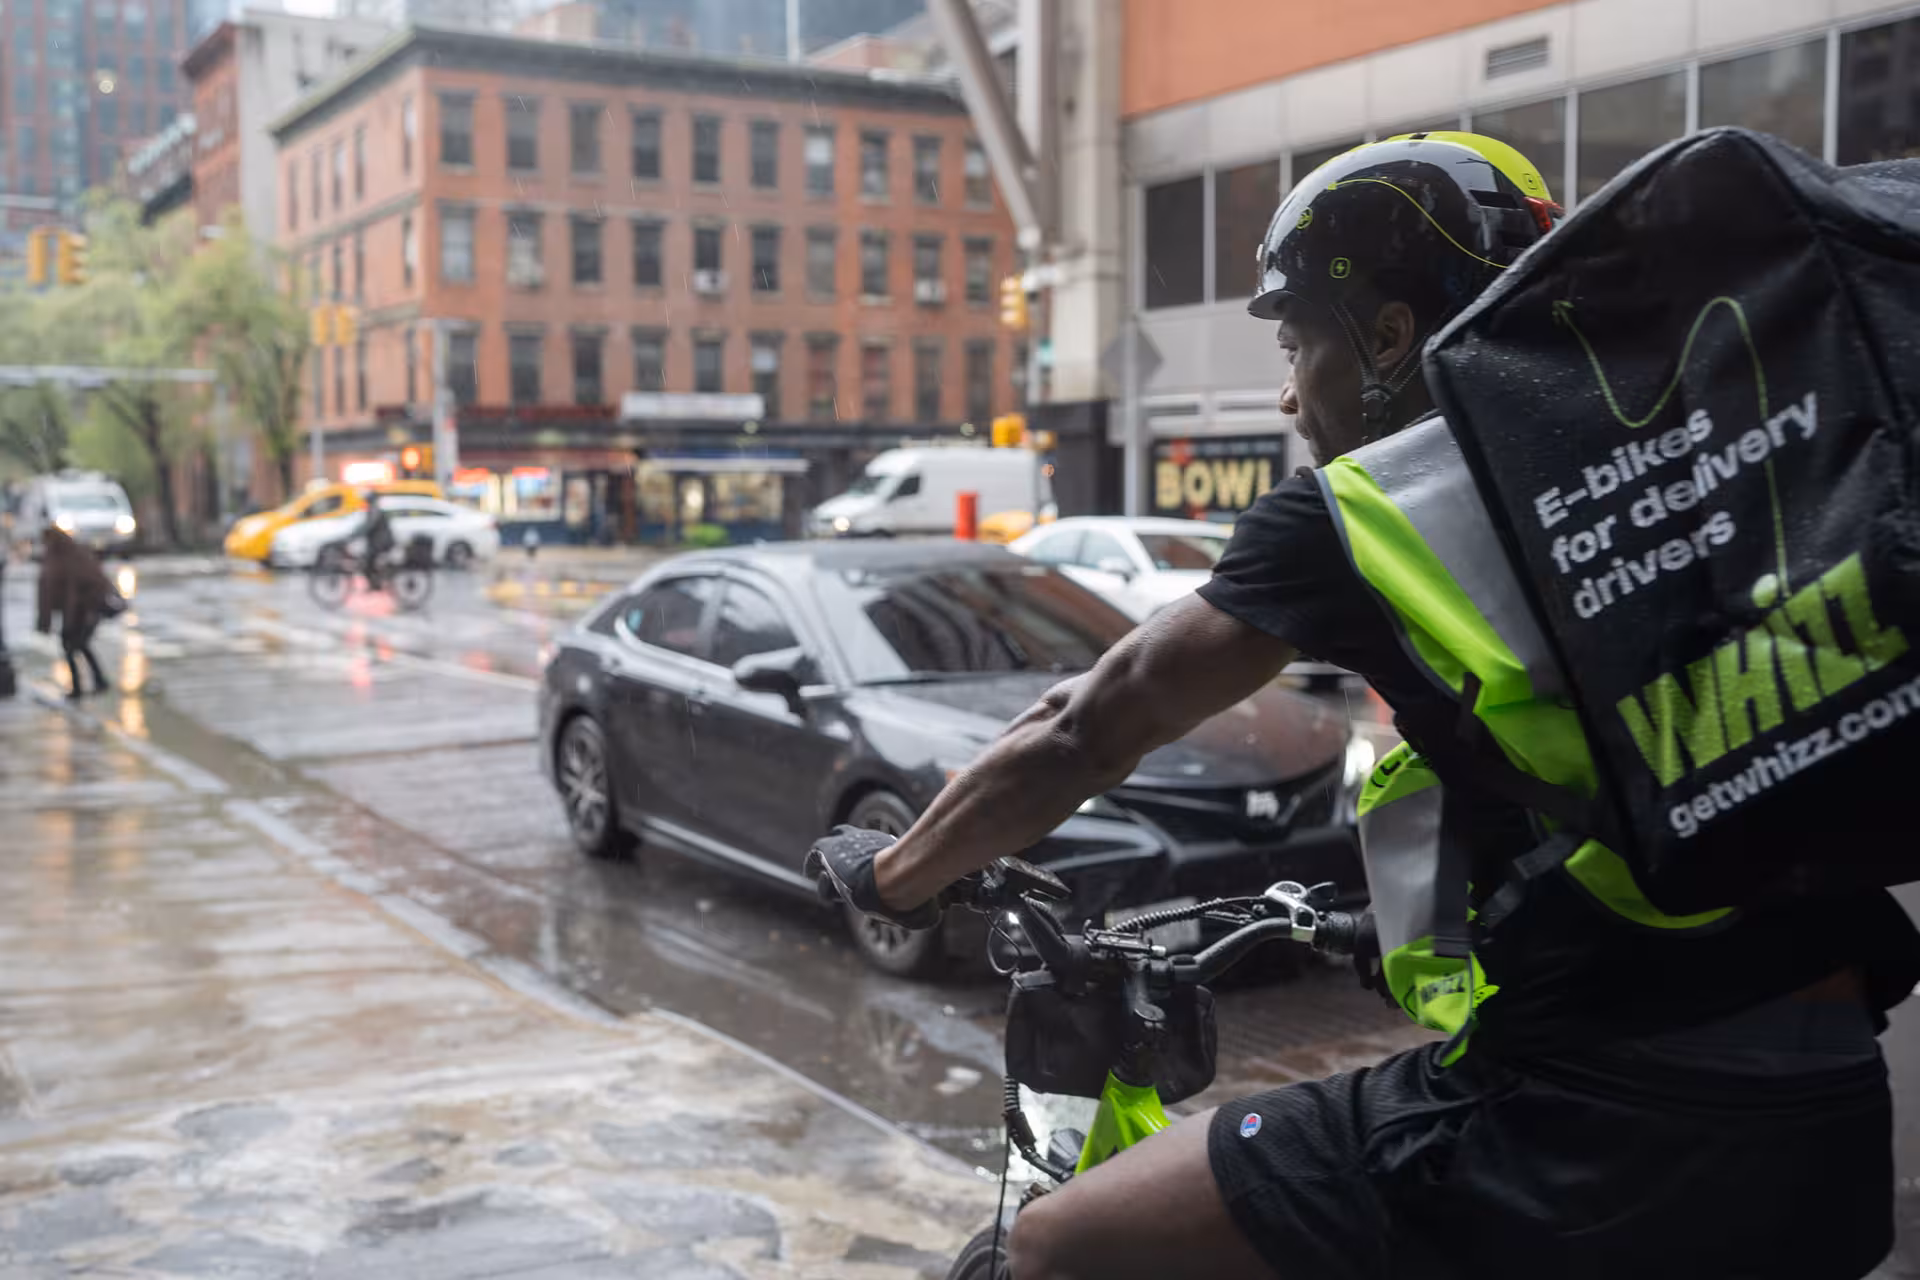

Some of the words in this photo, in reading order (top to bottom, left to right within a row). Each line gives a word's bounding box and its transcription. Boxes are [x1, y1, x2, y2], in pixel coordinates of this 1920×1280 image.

[1534, 408, 1714, 530] E-bikes
[1551, 514, 1617, 574] for
[1629, 391, 1818, 528] delivery
[1573, 510, 1737, 619] drivers
[1669, 674, 1920, 838] getwhizz.com
